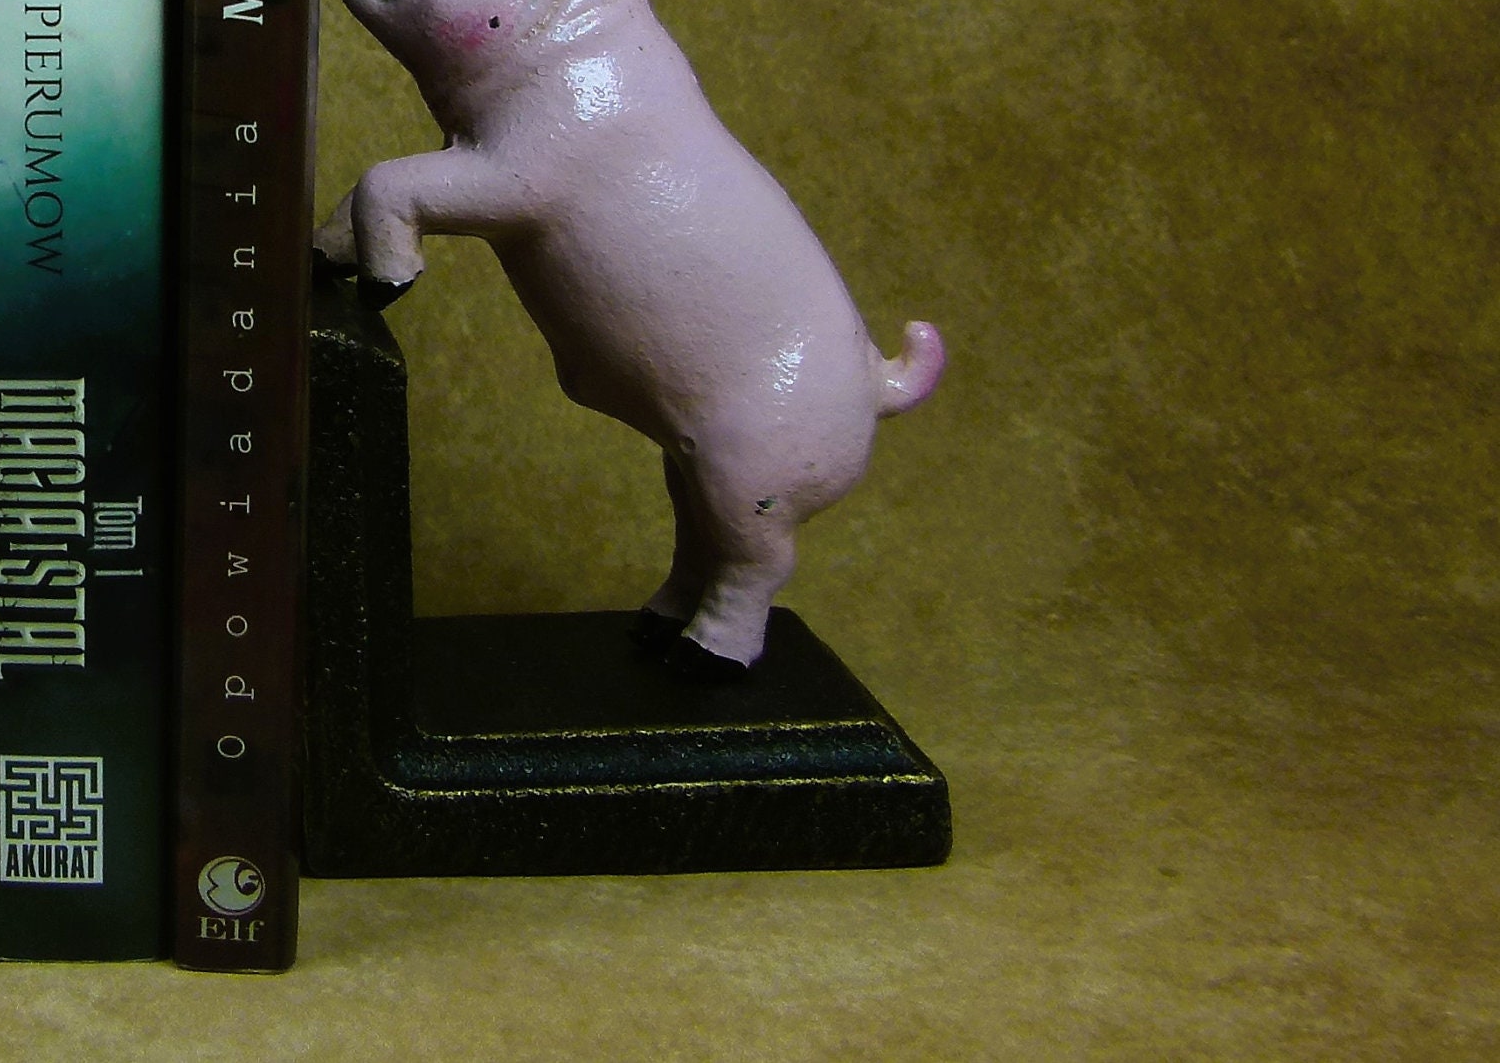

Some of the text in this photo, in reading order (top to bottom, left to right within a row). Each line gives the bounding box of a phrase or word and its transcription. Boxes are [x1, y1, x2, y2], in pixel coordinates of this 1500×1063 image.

[23, 3, 64, 277] PIERUMOW
[217, 119, 259, 761] opowiadania
[89, 495, 144, 577] Tom I
[5, 843, 98, 880] AKURAT
[196, 916, 265, 942] Elf
